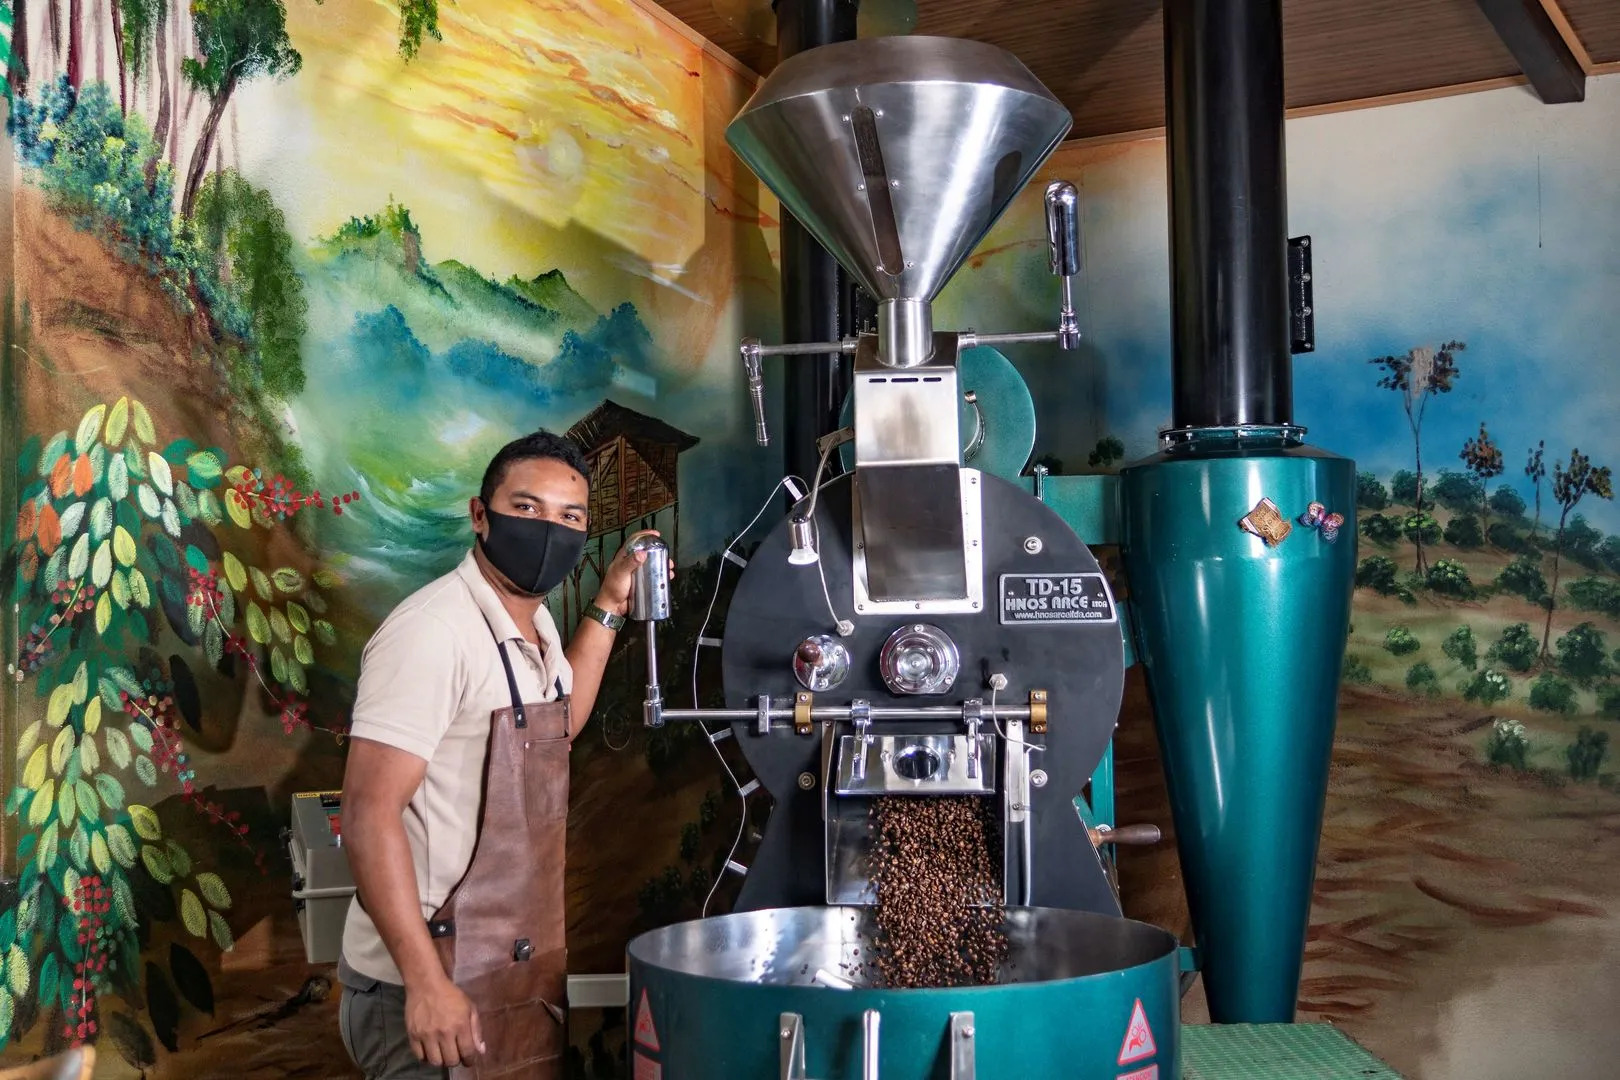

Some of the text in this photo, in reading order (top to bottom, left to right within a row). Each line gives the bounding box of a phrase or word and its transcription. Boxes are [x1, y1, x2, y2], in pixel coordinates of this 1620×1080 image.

[1026, 579, 1082, 595] TD-15
[1005, 596, 1108, 610] HNOS ARCE LTDA
